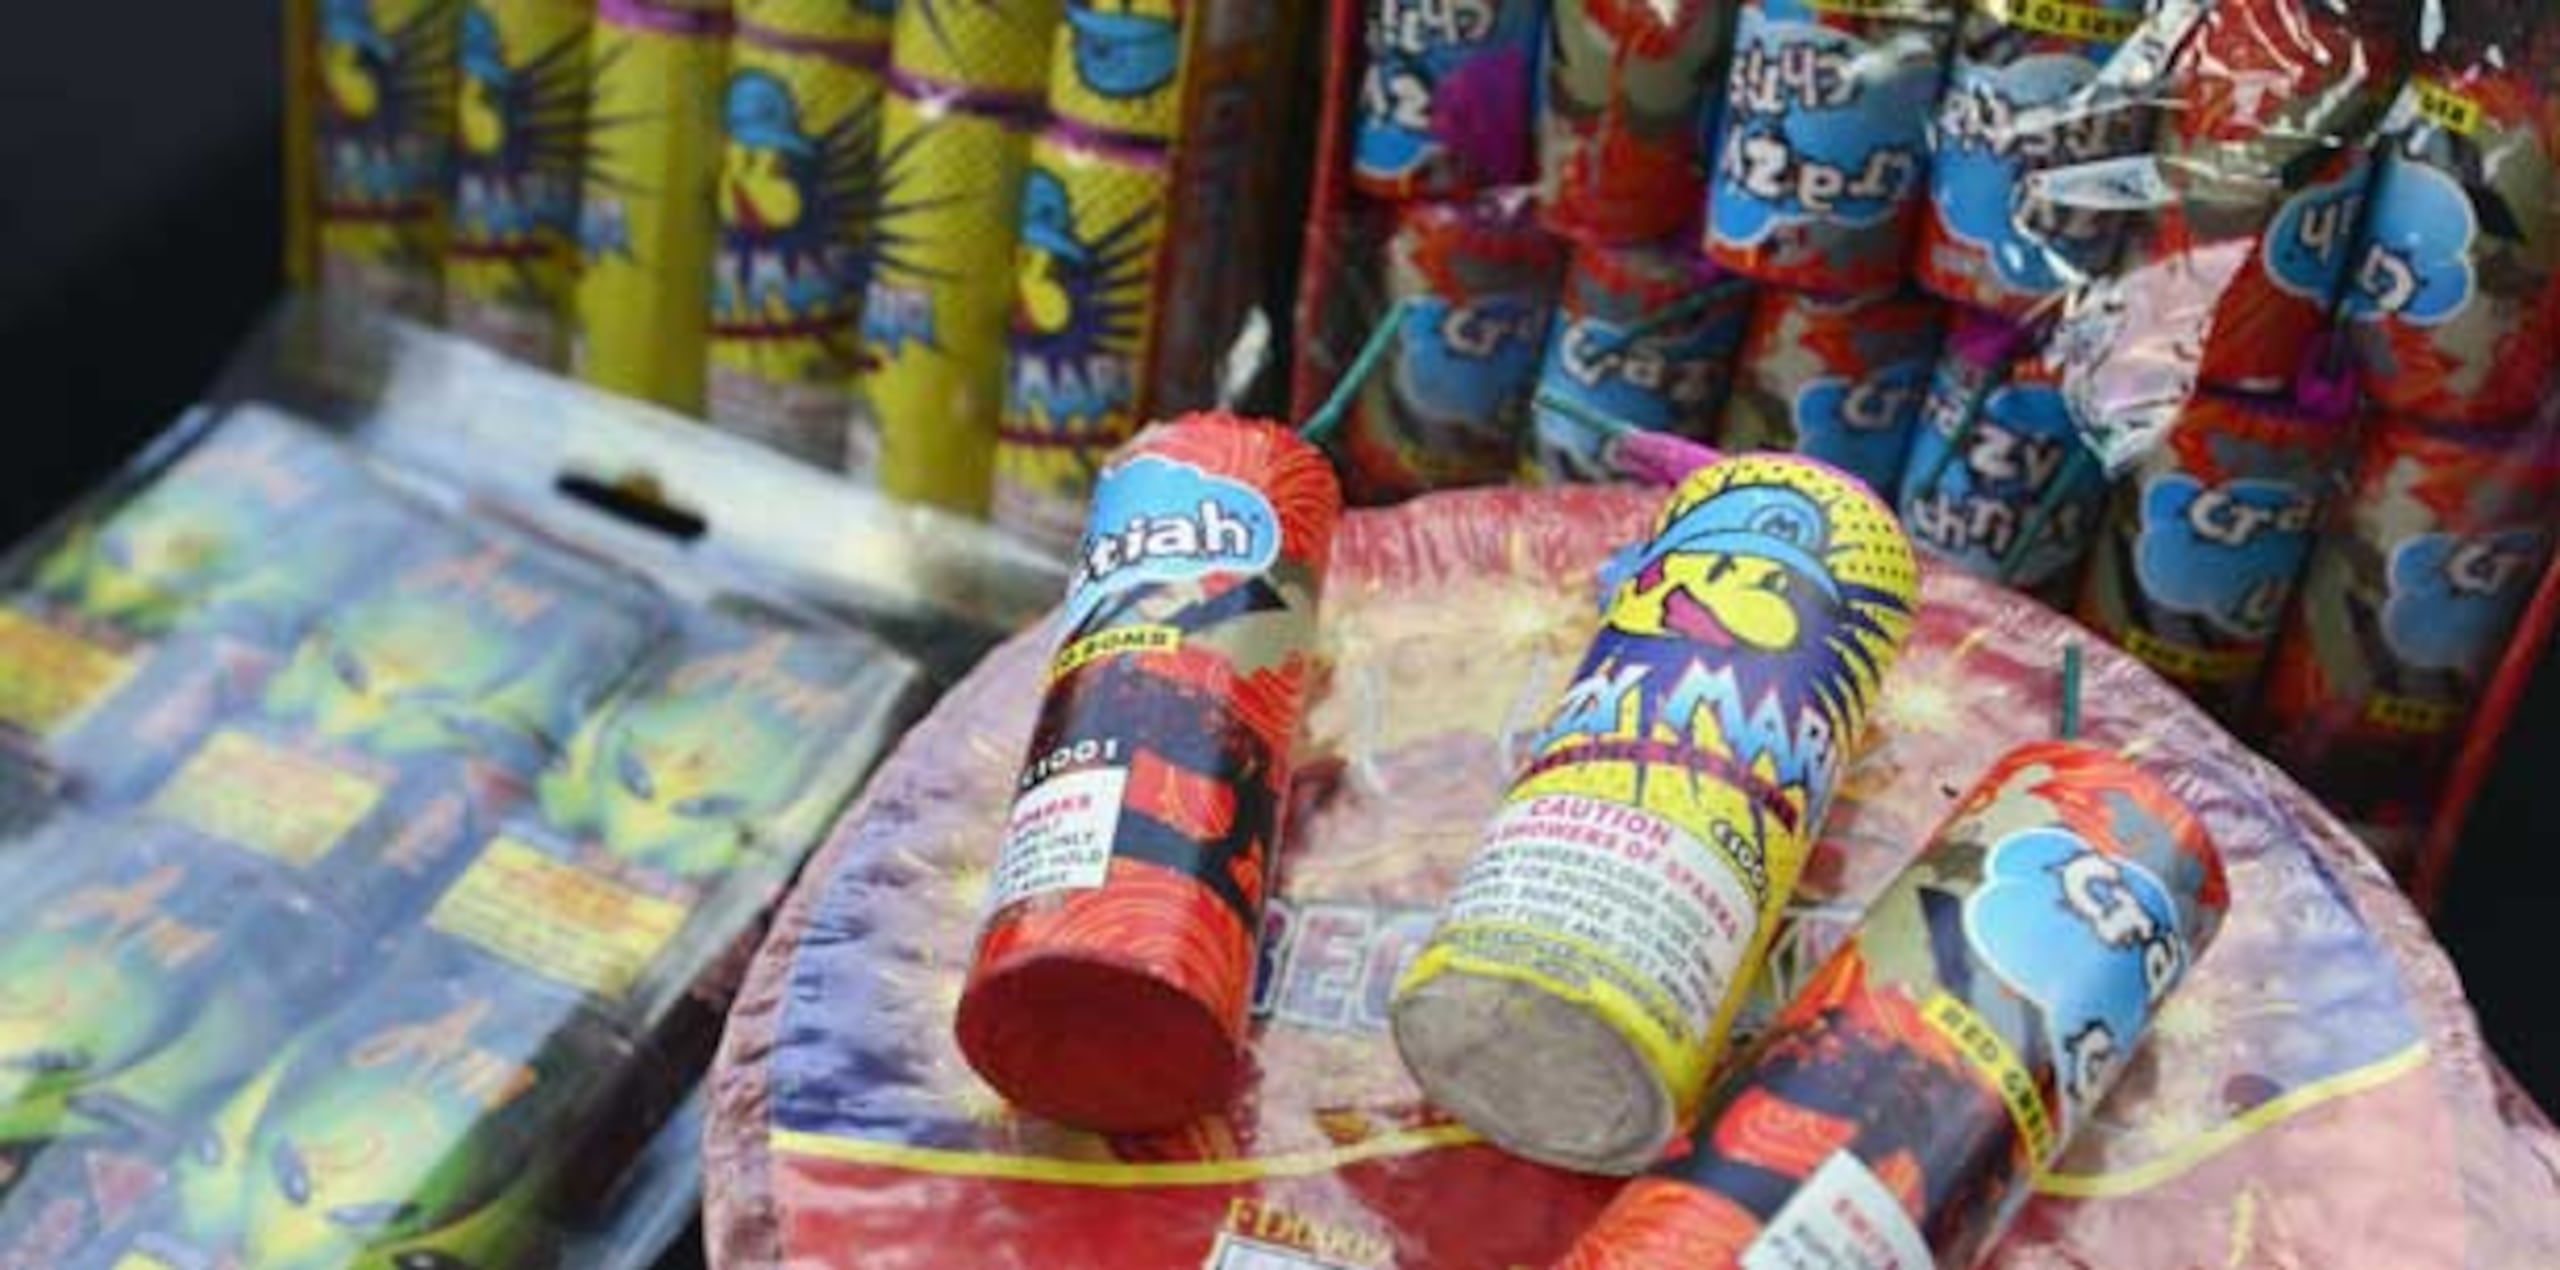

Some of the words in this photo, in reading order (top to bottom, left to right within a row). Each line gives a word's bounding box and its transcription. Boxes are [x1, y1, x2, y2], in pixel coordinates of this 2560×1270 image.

[1530, 797, 1672, 848] CAUTION
[1625, 840, 1659, 865] OF
[1938, 1004, 2002, 1063] RED
